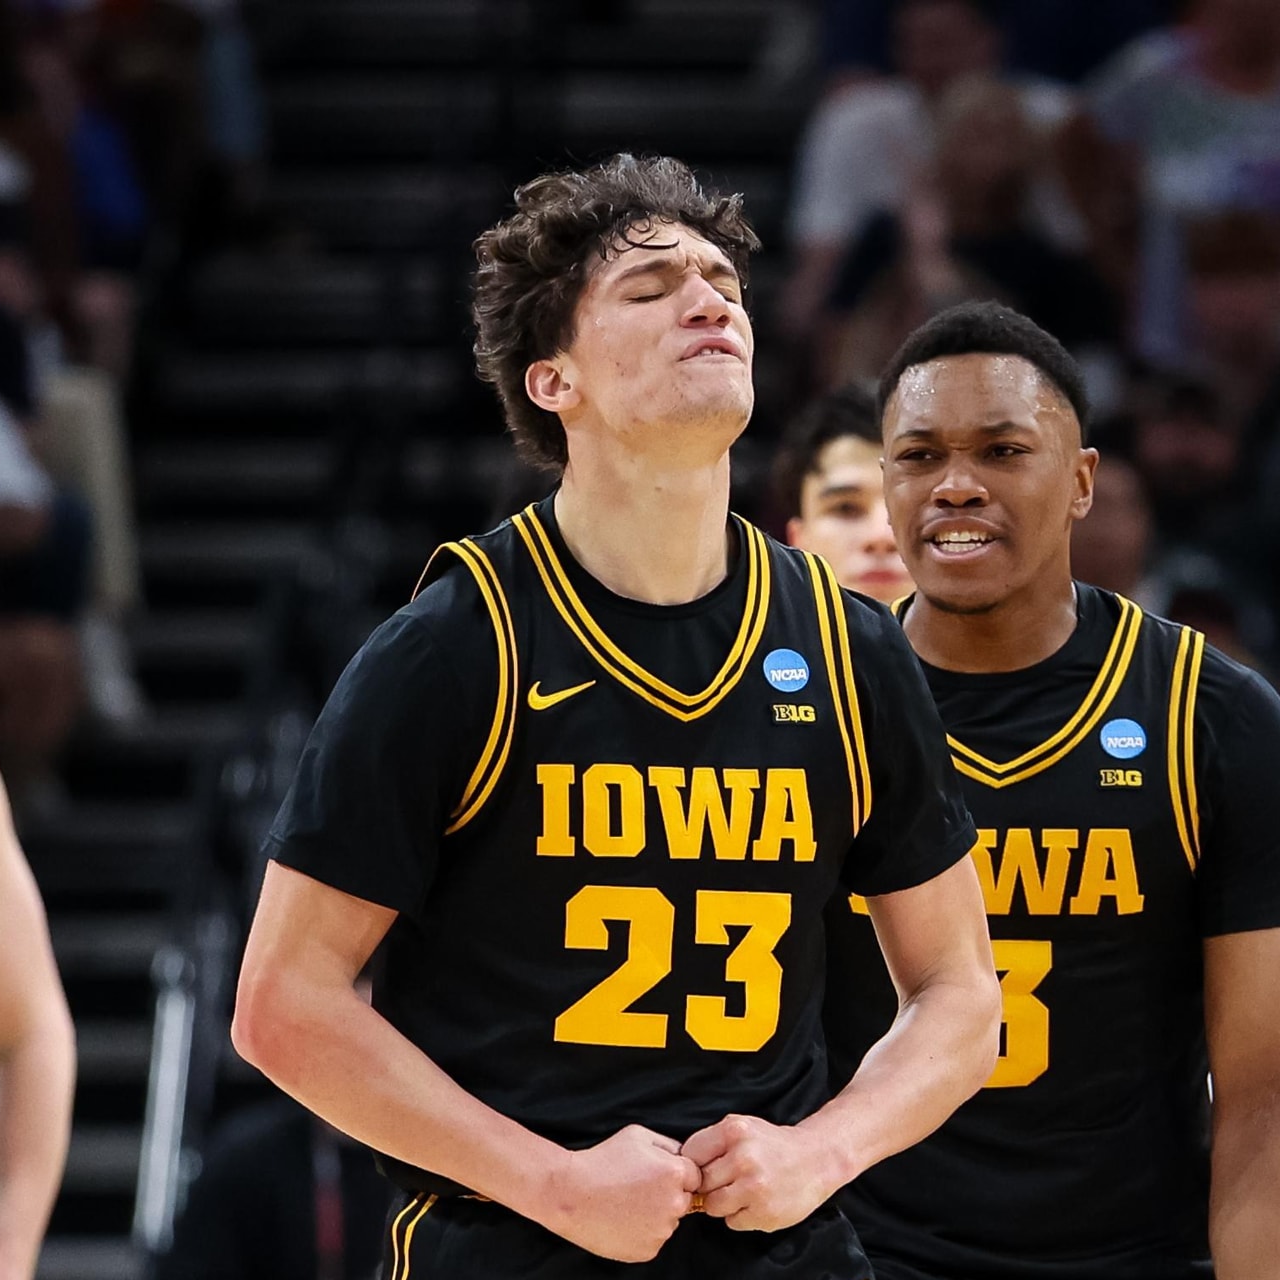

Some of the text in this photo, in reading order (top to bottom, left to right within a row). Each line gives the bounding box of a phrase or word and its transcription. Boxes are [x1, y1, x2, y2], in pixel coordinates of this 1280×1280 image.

[770, 668, 807, 682] NCAA
[1106, 737, 1143, 748] NCAA
[536, 763, 818, 863] IOWA
[554, 884, 792, 1052] 23
